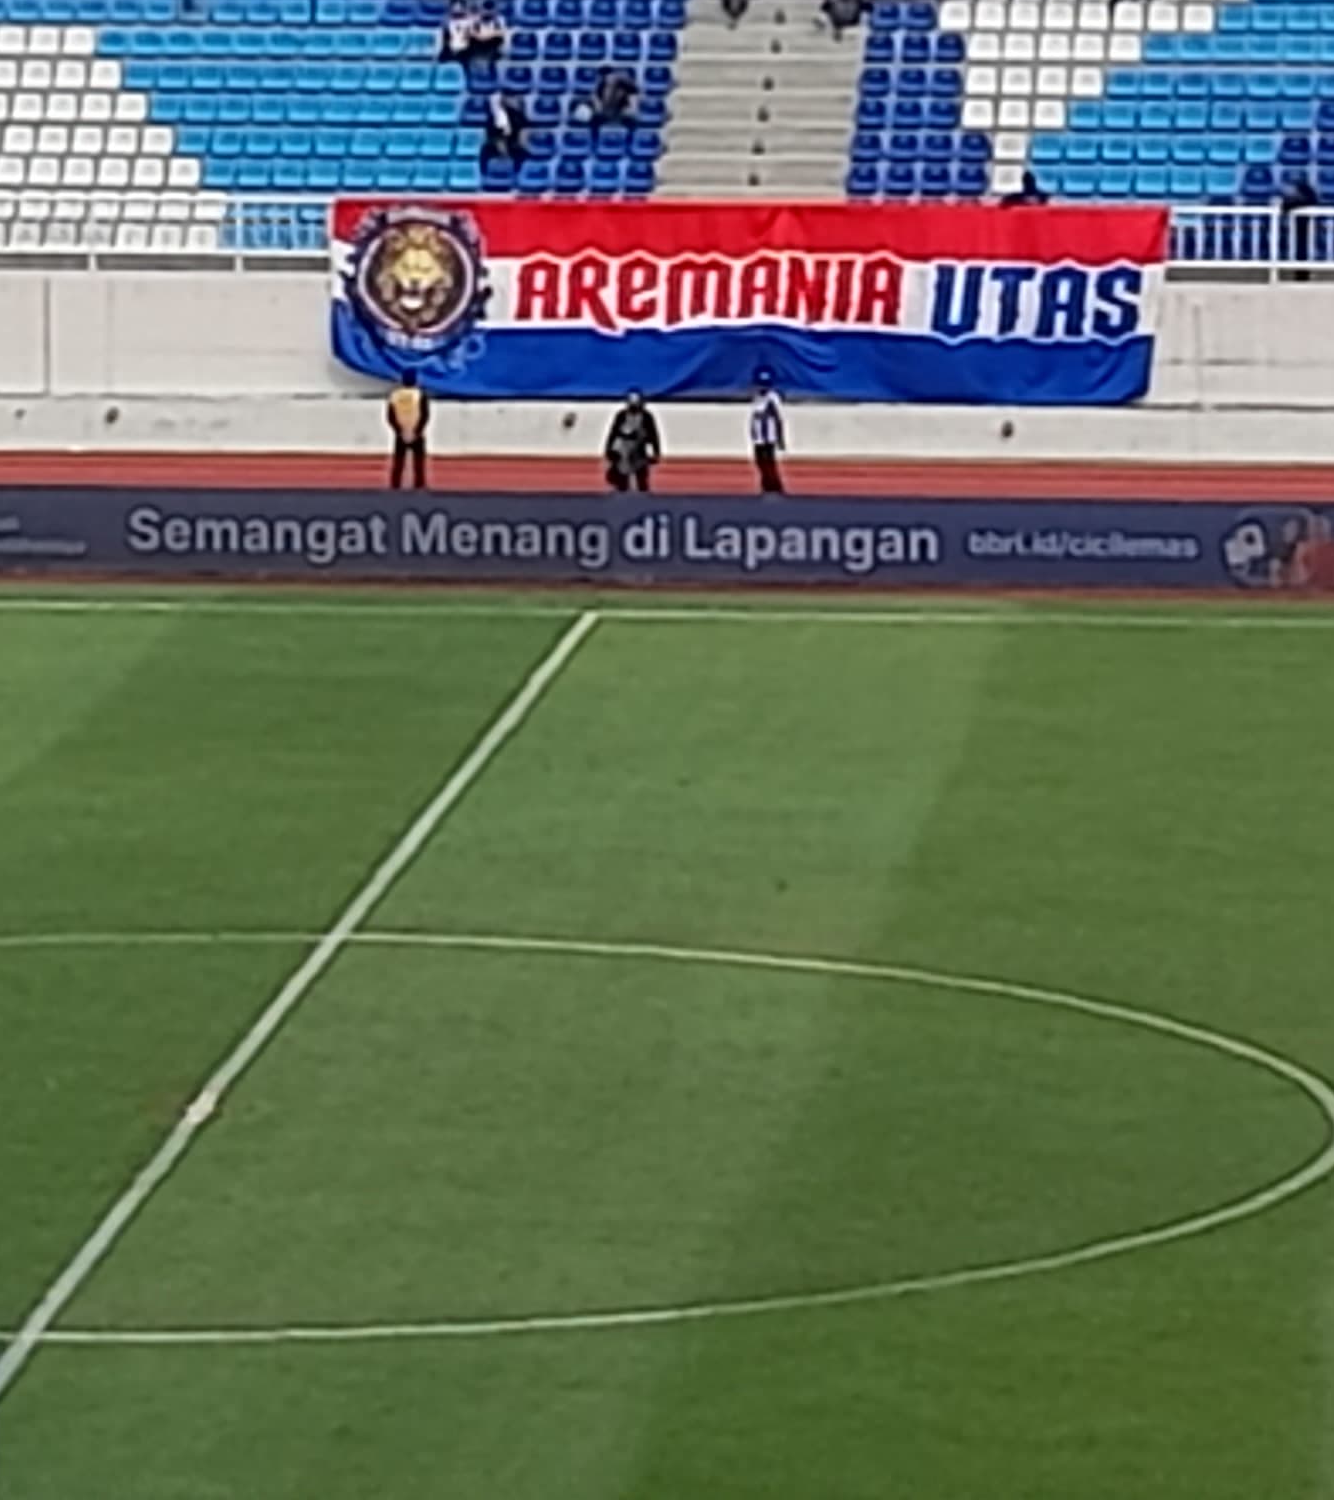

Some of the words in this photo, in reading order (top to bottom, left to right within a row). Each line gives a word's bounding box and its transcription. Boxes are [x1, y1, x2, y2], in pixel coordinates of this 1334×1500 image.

[514, 255, 904, 331] AREMANIA
[930, 263, 1142, 338] UTAS
[128, 508, 387, 564] Semangat
[401, 512, 610, 567] Menang
[623, 514, 670, 557] di
[684, 516, 939, 571] Lapangan
